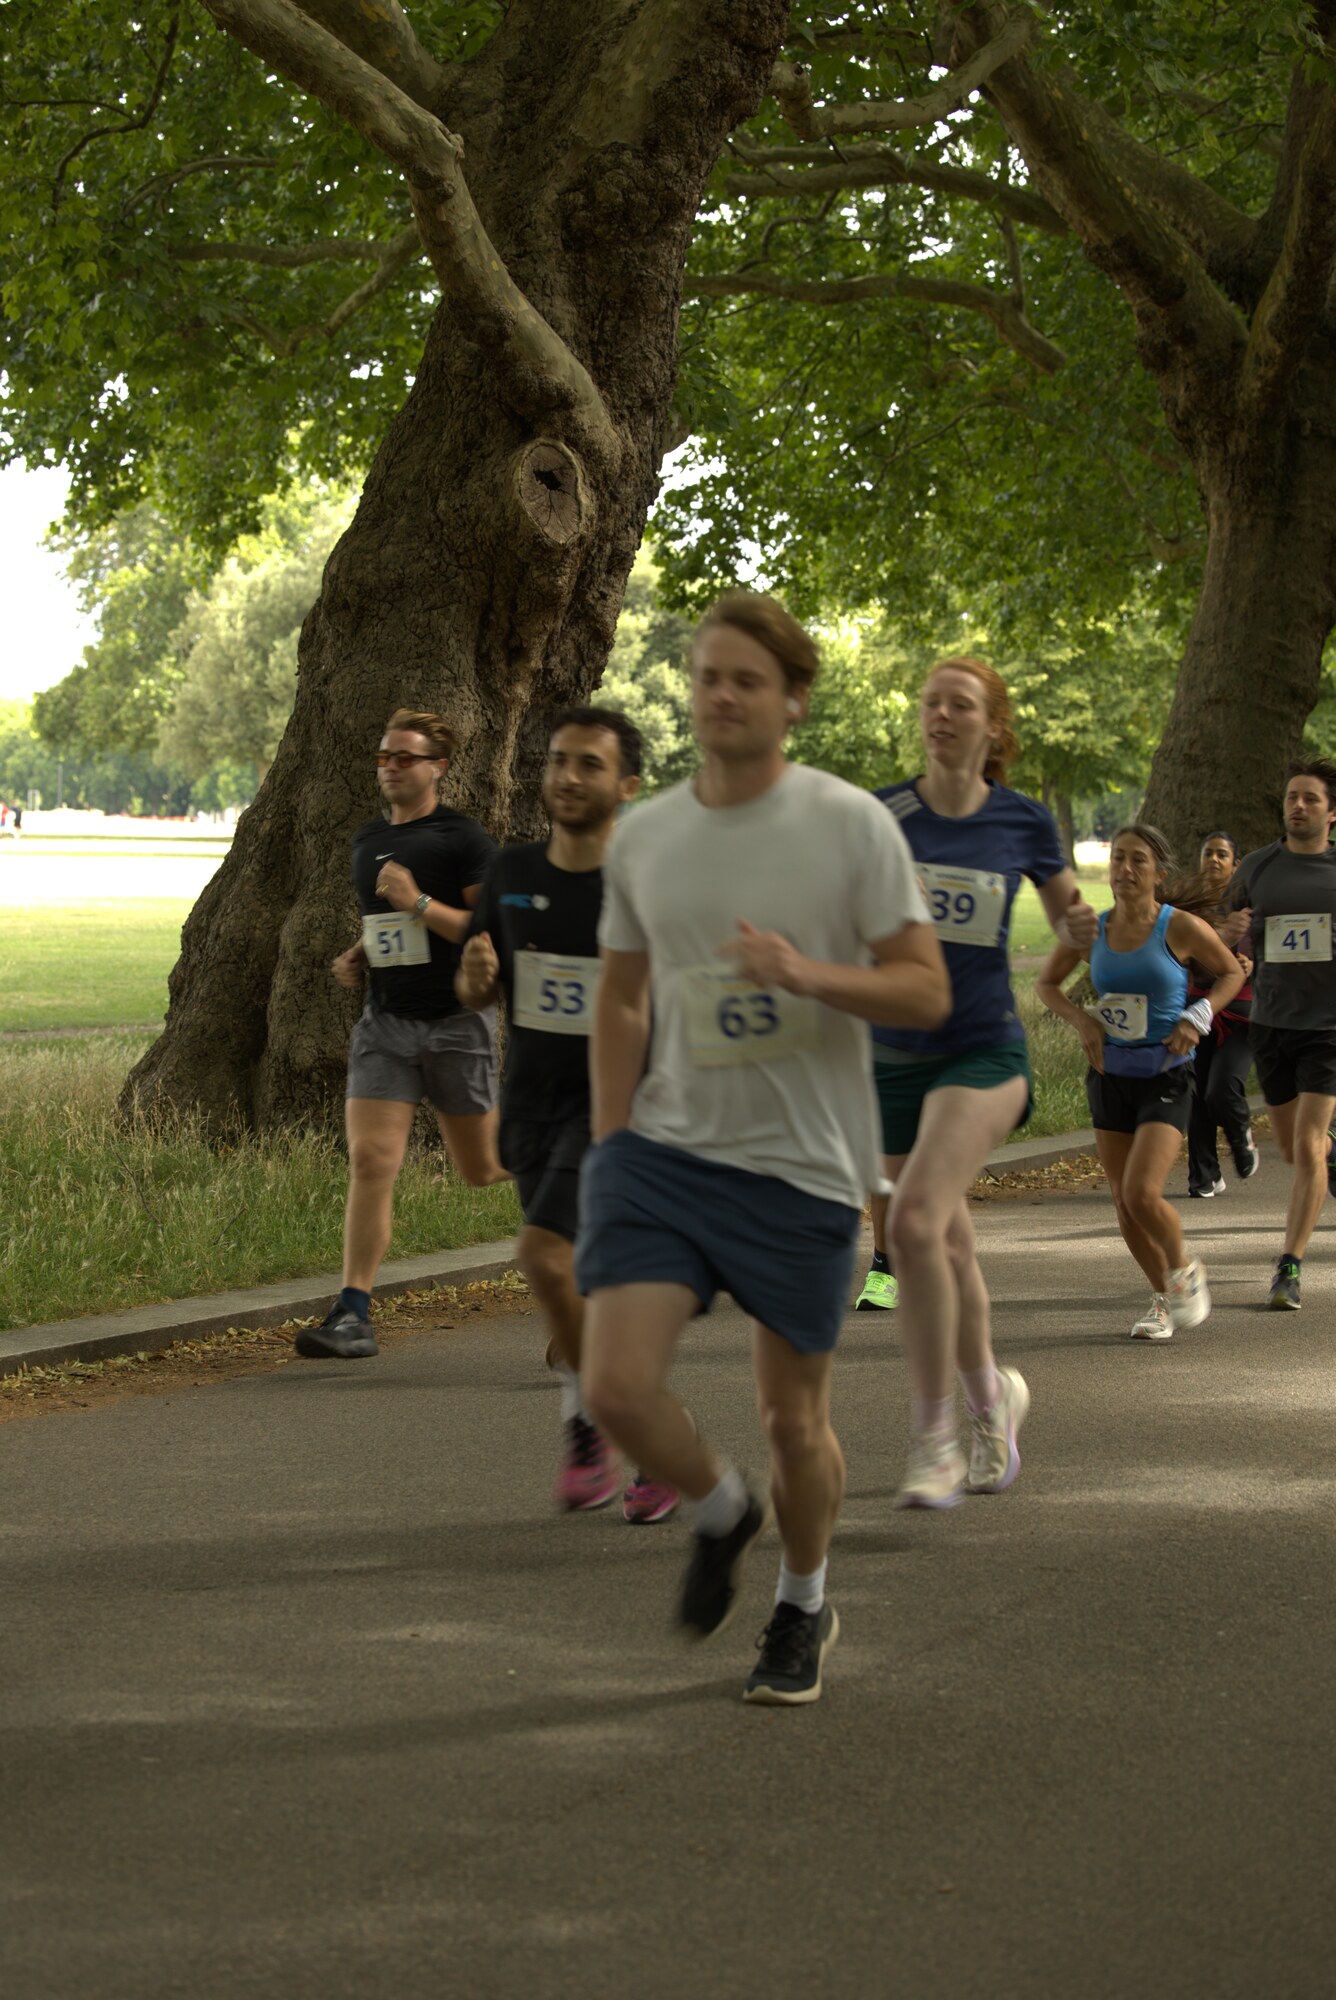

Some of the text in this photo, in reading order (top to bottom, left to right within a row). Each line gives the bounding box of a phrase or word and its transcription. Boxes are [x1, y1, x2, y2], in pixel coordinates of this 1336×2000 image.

[931, 889, 975, 924] 39
[377, 929, 404, 954] 51
[1282, 929, 1309, 950] 41
[539, 980, 585, 1015] 53
[718, 994, 780, 1039] 63
[1101, 1008, 1129, 1030] 82
